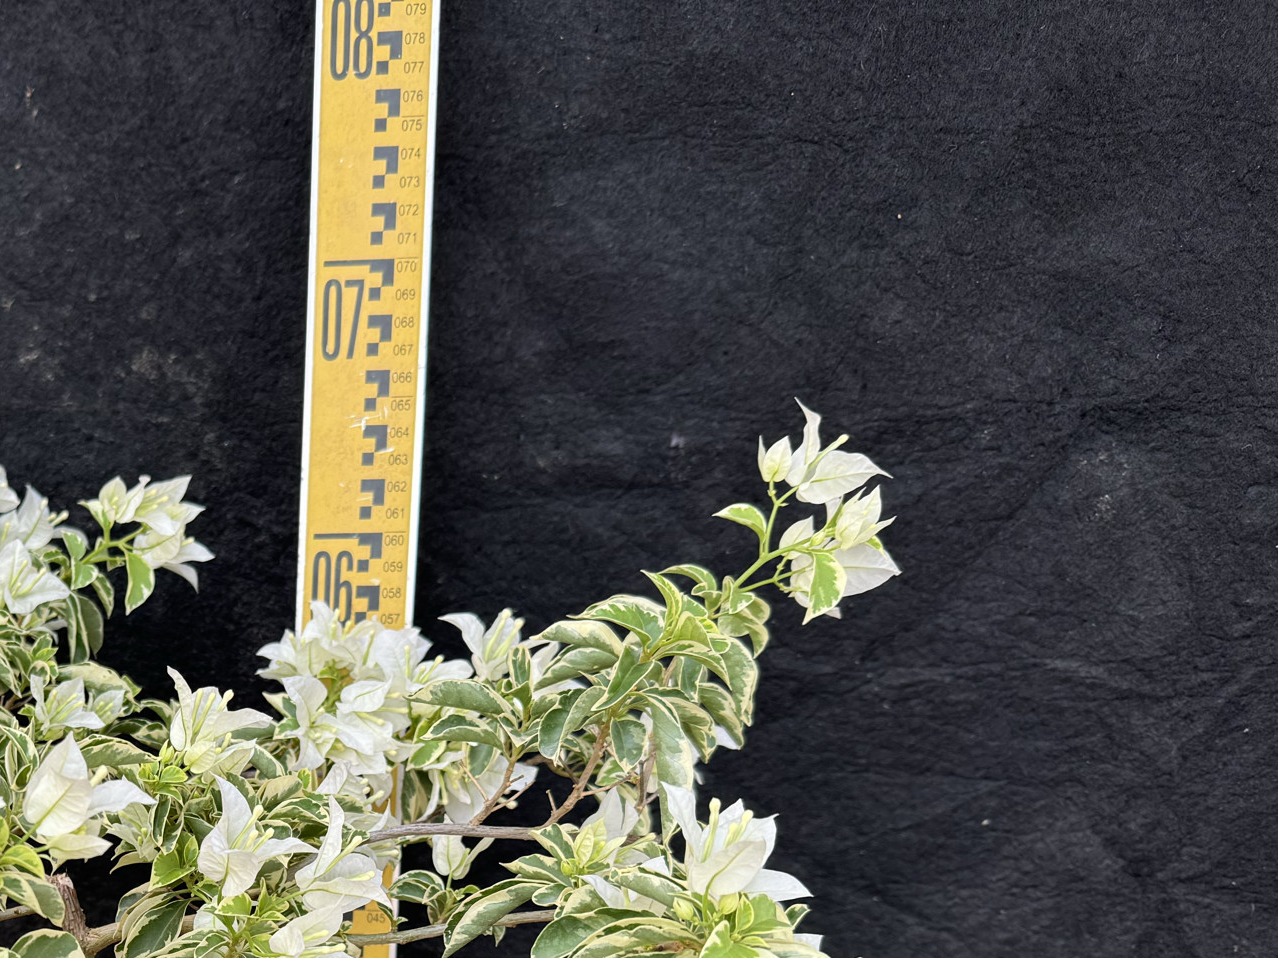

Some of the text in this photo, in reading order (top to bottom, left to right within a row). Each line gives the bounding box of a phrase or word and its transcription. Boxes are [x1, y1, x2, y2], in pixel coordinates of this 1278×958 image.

[406, 3, 426, 15] 079
[330, 0, 374, 81] 08
[404, 32, 425, 45] 078
[403, 61, 424, 74] 077
[402, 90, 423, 102] 076
[401, 119, 422, 132] 075
[400, 148, 421, 160] 074
[399, 176, 420, 188] 073
[398, 204, 419, 216] 072
[397, 232, 417, 244] 071
[396, 260, 417, 273] 070
[395, 288, 416, 301] 069
[322, 279, 364, 361] 07
[394, 316, 414, 328] 068
[393, 344, 413, 356] 067
[392, 371, 412, 383] 066
[391, 399, 411, 411] 065
[389, 427, 409, 438] 064
[388, 454, 408, 466] 063
[387, 481, 407, 493] 062
[386, 508, 405, 519] 061
[384, 534, 404, 546] 060
[383, 561, 403, 573] 059
[311, 550, 353, 628] 06
[381, 587, 402, 599] 058
[380, 613, 400, 625] 057
[367, 912, 386, 923] 045
